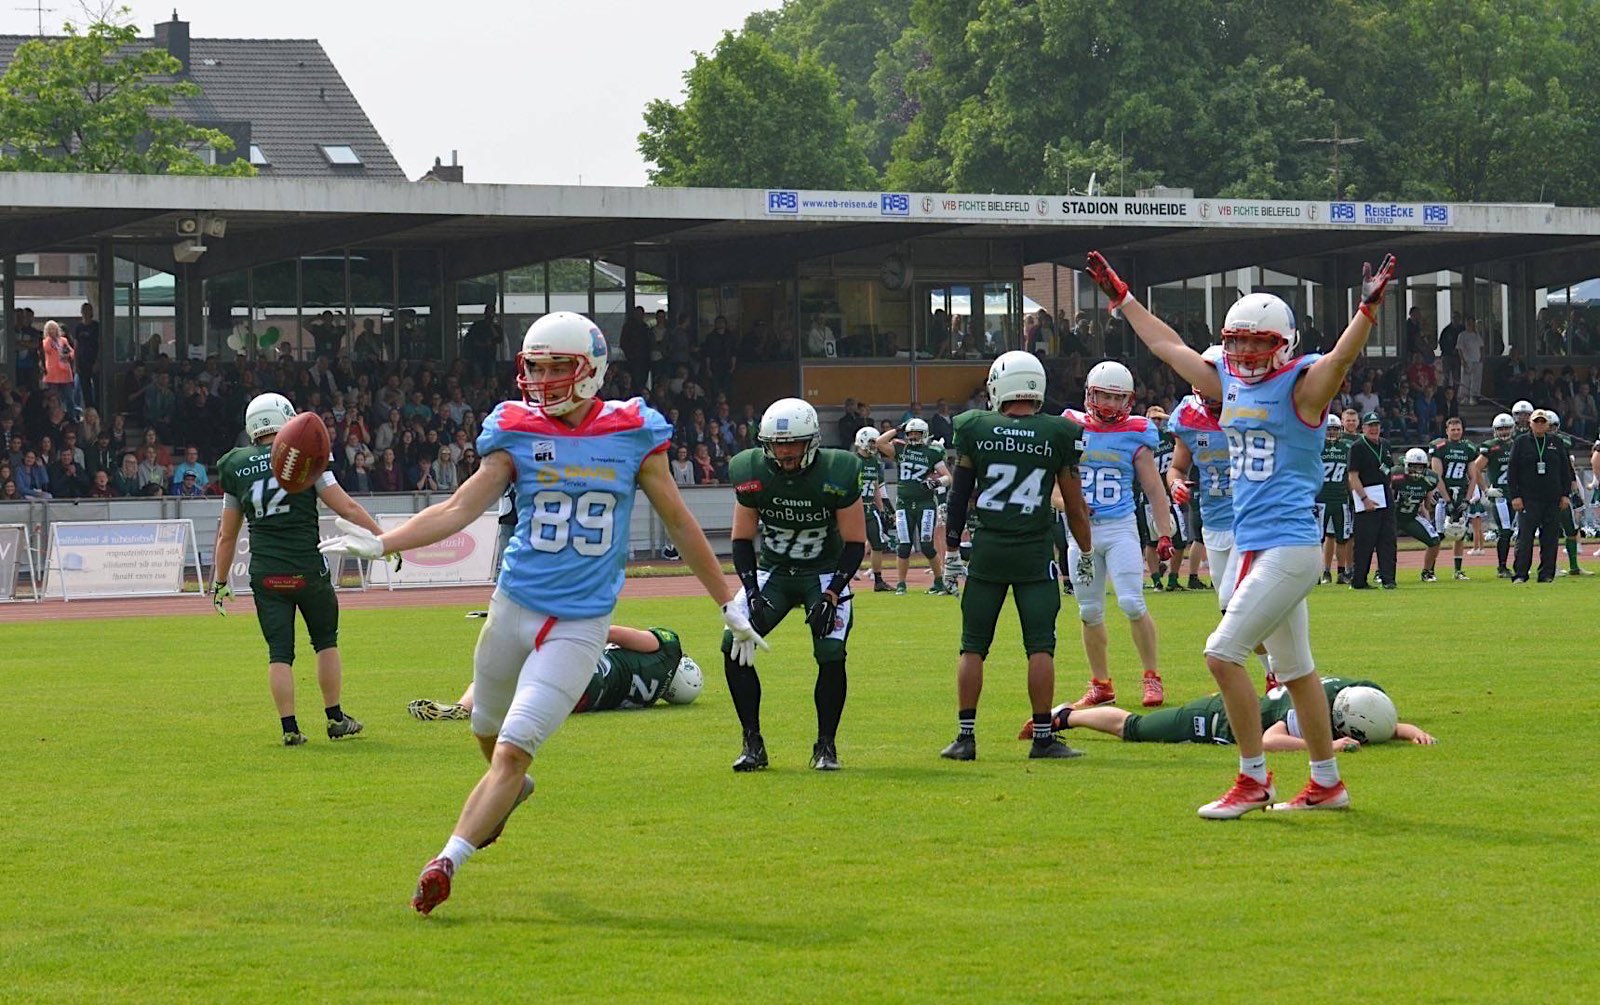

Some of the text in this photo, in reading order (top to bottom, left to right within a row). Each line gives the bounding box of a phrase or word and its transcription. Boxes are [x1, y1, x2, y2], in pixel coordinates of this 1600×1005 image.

[770, 192, 796, 208] REB
[802, 199, 878, 209] www.reb-reisen.de
[882, 194, 908, 211] REB
[958, 201, 986, 211] FICHTE
[987, 201, 1030, 212] BIELEFELD
[1062, 201, 1118, 215] STADION
[1233, 206, 1260, 216] FICHTE
[1261, 207, 1300, 217] BIELEFELD
[1331, 203, 1354, 219] REB
[1424, 206, 1446, 221] REB
[993, 426, 1035, 437] Canon
[976, 437, 1052, 457] vonBusch
[249, 452, 272, 461] Can
[534, 451, 554, 461] GFL
[900, 461, 929, 482] 62
[976, 463, 1046, 515] 24
[1078, 465, 1122, 505] 26
[249, 476, 291, 519] 12
[772, 497, 812, 507] Canon
[759, 506, 831, 522] vonBusch
[530, 490, 617, 557] 89
